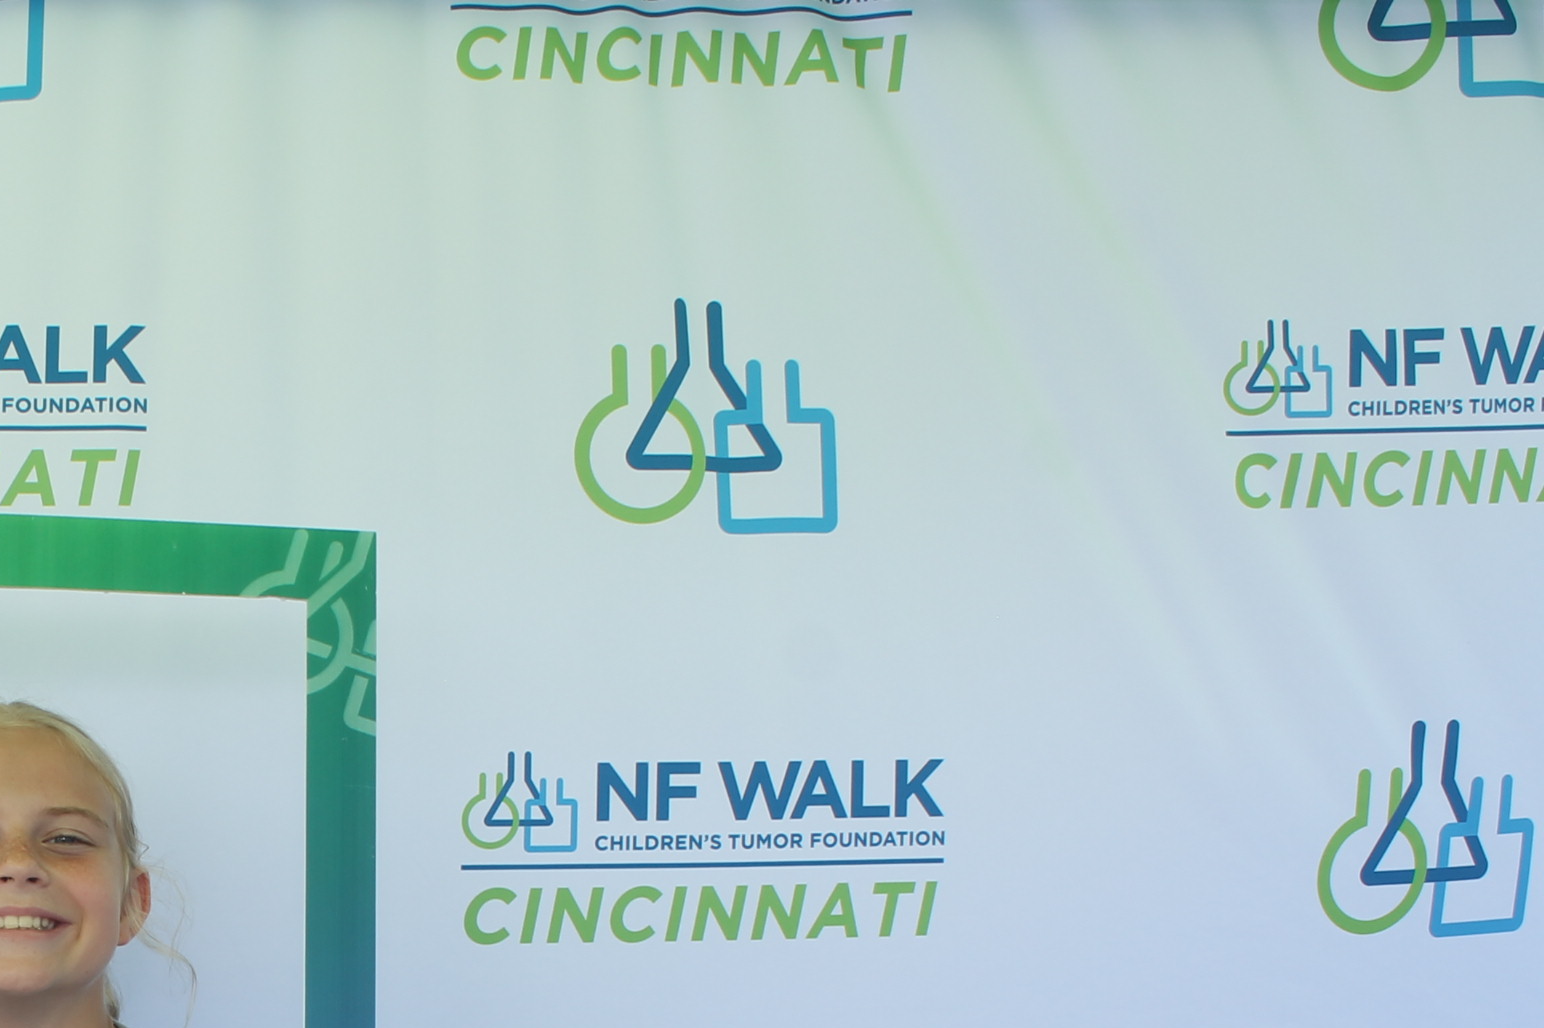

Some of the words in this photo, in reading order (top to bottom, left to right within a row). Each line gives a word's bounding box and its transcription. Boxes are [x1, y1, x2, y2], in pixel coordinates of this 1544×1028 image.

[456, 25, 907, 93] CINCINNATI
[1348, 327, 1445, 388] NF
[1, 396, 148, 415] FOUNDATION
[1347, 398, 1463, 417] CHILDREN'S
[1469, 397, 1536, 414] TUMOR
[1235, 447, 1544, 509] CINCINN
[595, 761, 702, 822] NF
[717, 758, 945, 821] WALK
[594, 833, 722, 852] CHILDREN'S
[727, 832, 803, 850] TUMOR
[809, 830, 946, 849] FOUNDATION
[463, 880, 939, 946] CINCINNATI
